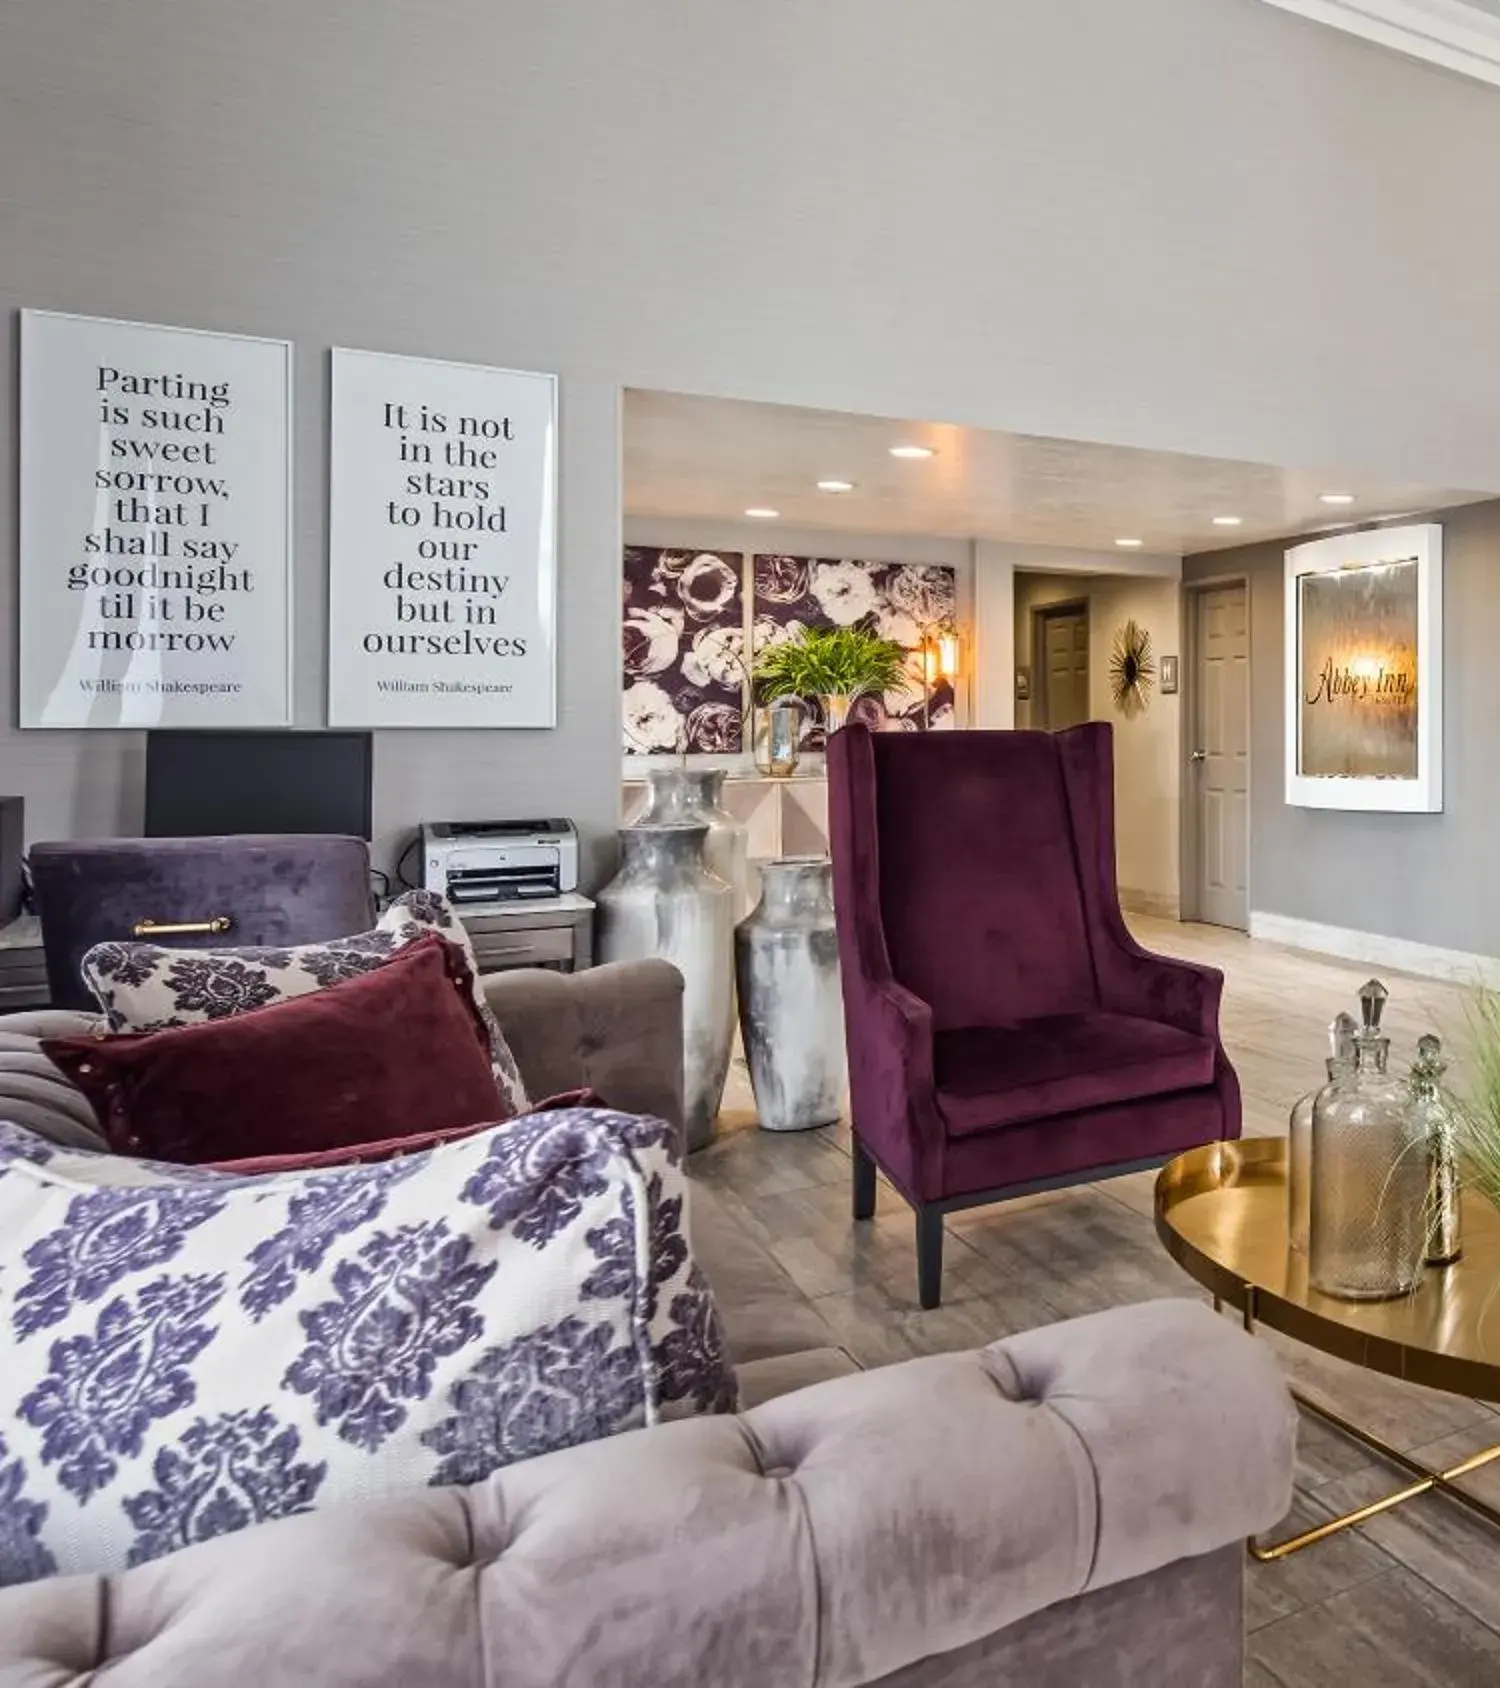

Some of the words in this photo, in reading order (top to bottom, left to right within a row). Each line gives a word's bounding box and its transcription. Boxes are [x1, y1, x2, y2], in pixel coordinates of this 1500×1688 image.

[96, 366, 230, 407] Parting
[101, 398, 128, 425] is
[141, 407, 227, 434] such
[384, 403, 410, 431] It
[420, 405, 448, 432] is
[457, 417, 514, 441] not
[111, 438, 216, 464] sweet
[400, 435, 432, 464] in
[445, 439, 496, 469] the
[96, 469, 228, 500] sorrow,
[406, 472, 489, 501] stars
[114, 497, 189, 527] that
[200, 504, 208, 527] I
[386, 501, 421, 526] to
[432, 501, 506, 533] hold
[85, 527, 169, 557] shall
[183, 538, 238, 564] say
[418, 539, 478, 561] our
[67, 562, 254, 595] goodnight
[384, 562, 509, 599] destiny
[100, 593, 136, 619] til
[150, 596, 174, 620] it
[185, 596, 224, 623] be
[397, 595, 454, 623] but
[465, 598, 496, 625] in
[88, 631, 235, 652] morrow
[363, 629, 526, 656] ourselves
[146, 680, 242, 695] Shakespeare
[377, 679, 429, 694] William
[431, 679, 512, 695] Shakespeare
[1306, 656, 1371, 704] Abbey
[1375, 667, 1407, 693] Inn
